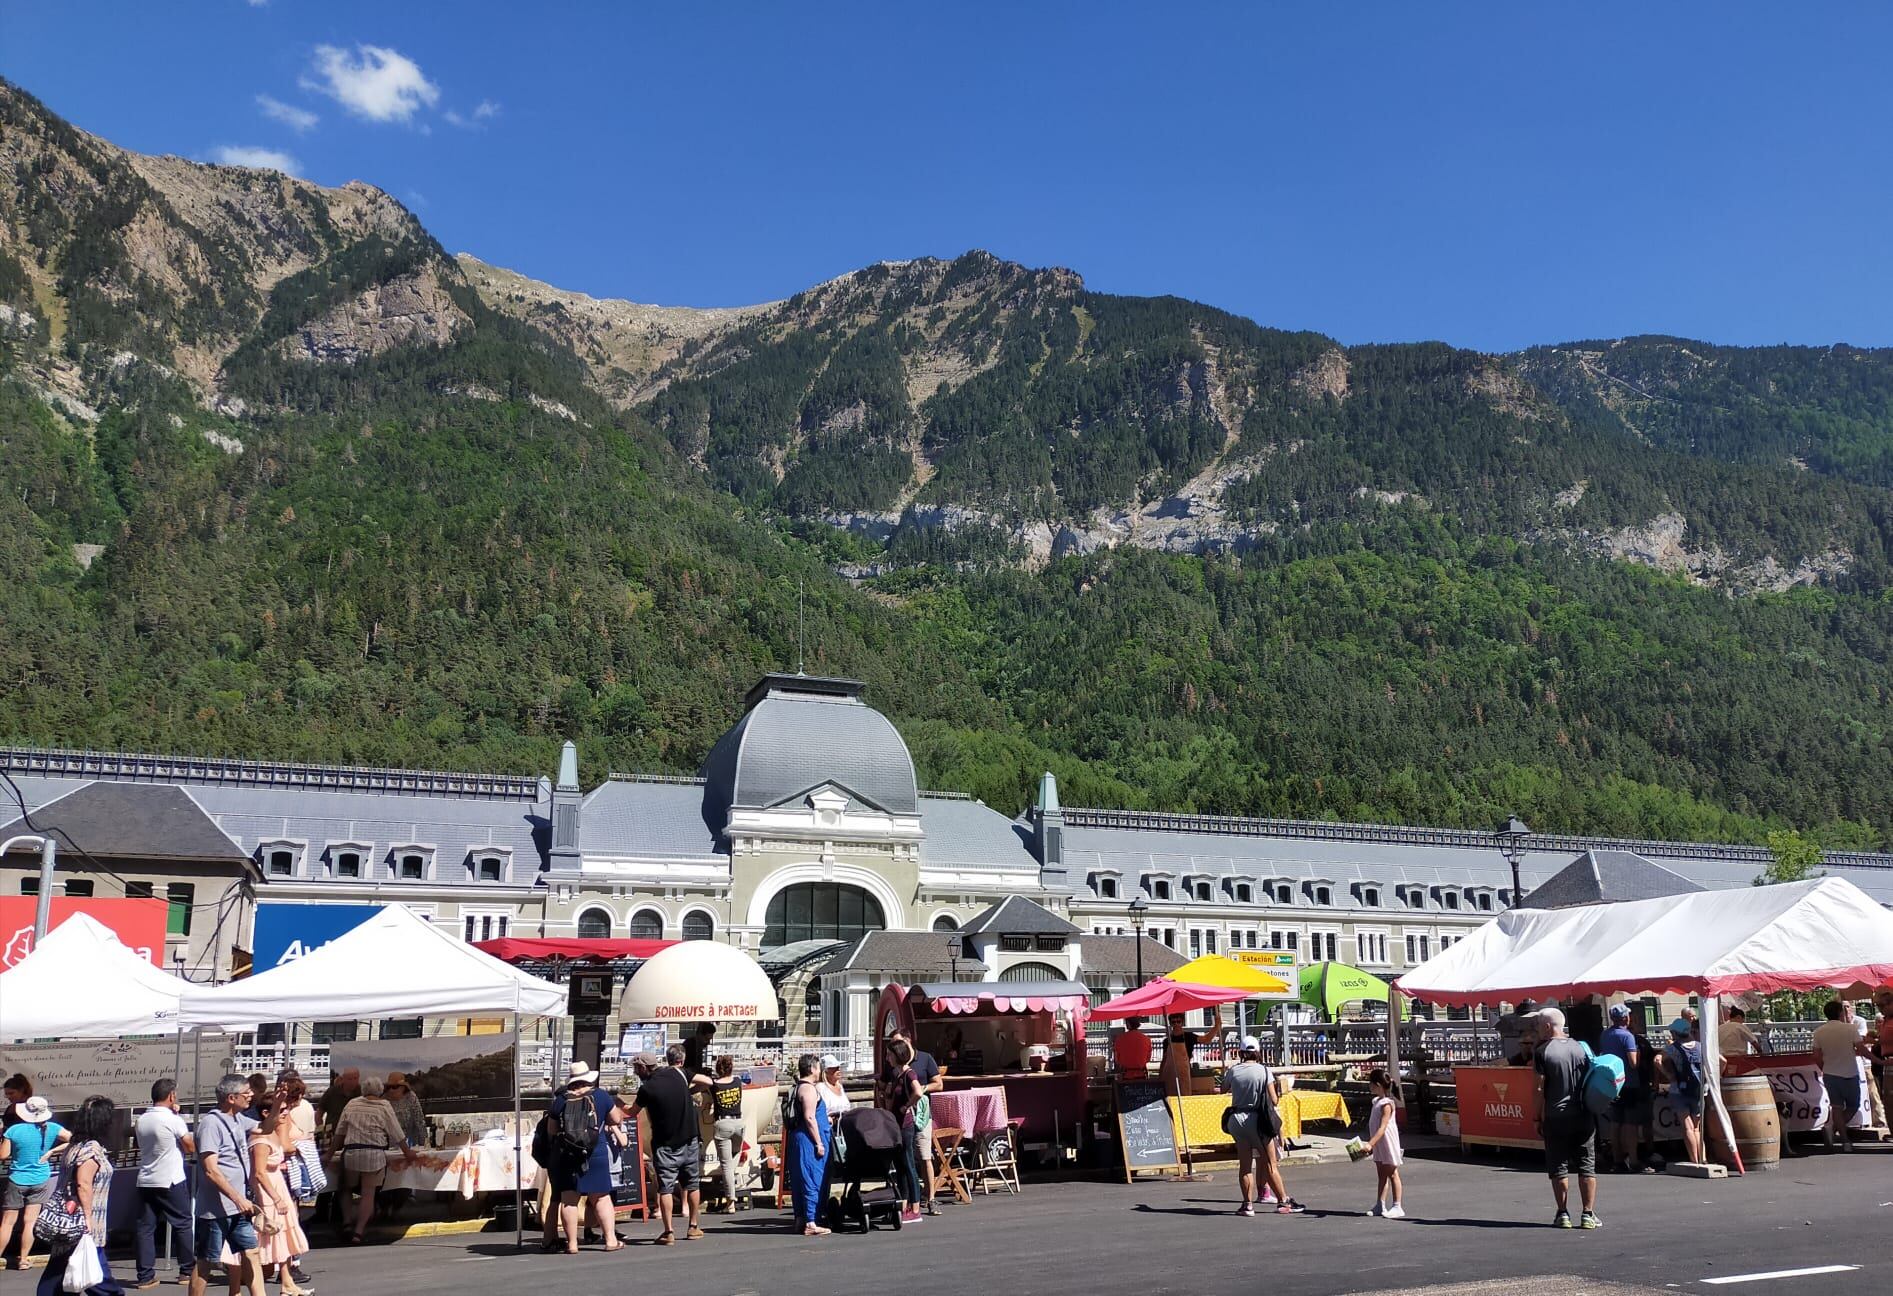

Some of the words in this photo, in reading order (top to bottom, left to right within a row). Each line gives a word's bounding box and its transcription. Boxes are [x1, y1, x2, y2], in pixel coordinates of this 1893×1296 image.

[1242, 955, 1272, 963] Estación
[65, 1070, 74, 1079] de
[103, 1068, 112, 1077] de
[114, 1067, 137, 1078] fleurs
[139, 1066, 146, 1074] et
[149, 1066, 158, 1074] de
[1484, 1103, 1524, 1119] AMBAR
[39, 1208, 86, 1229] AUSTRIA
